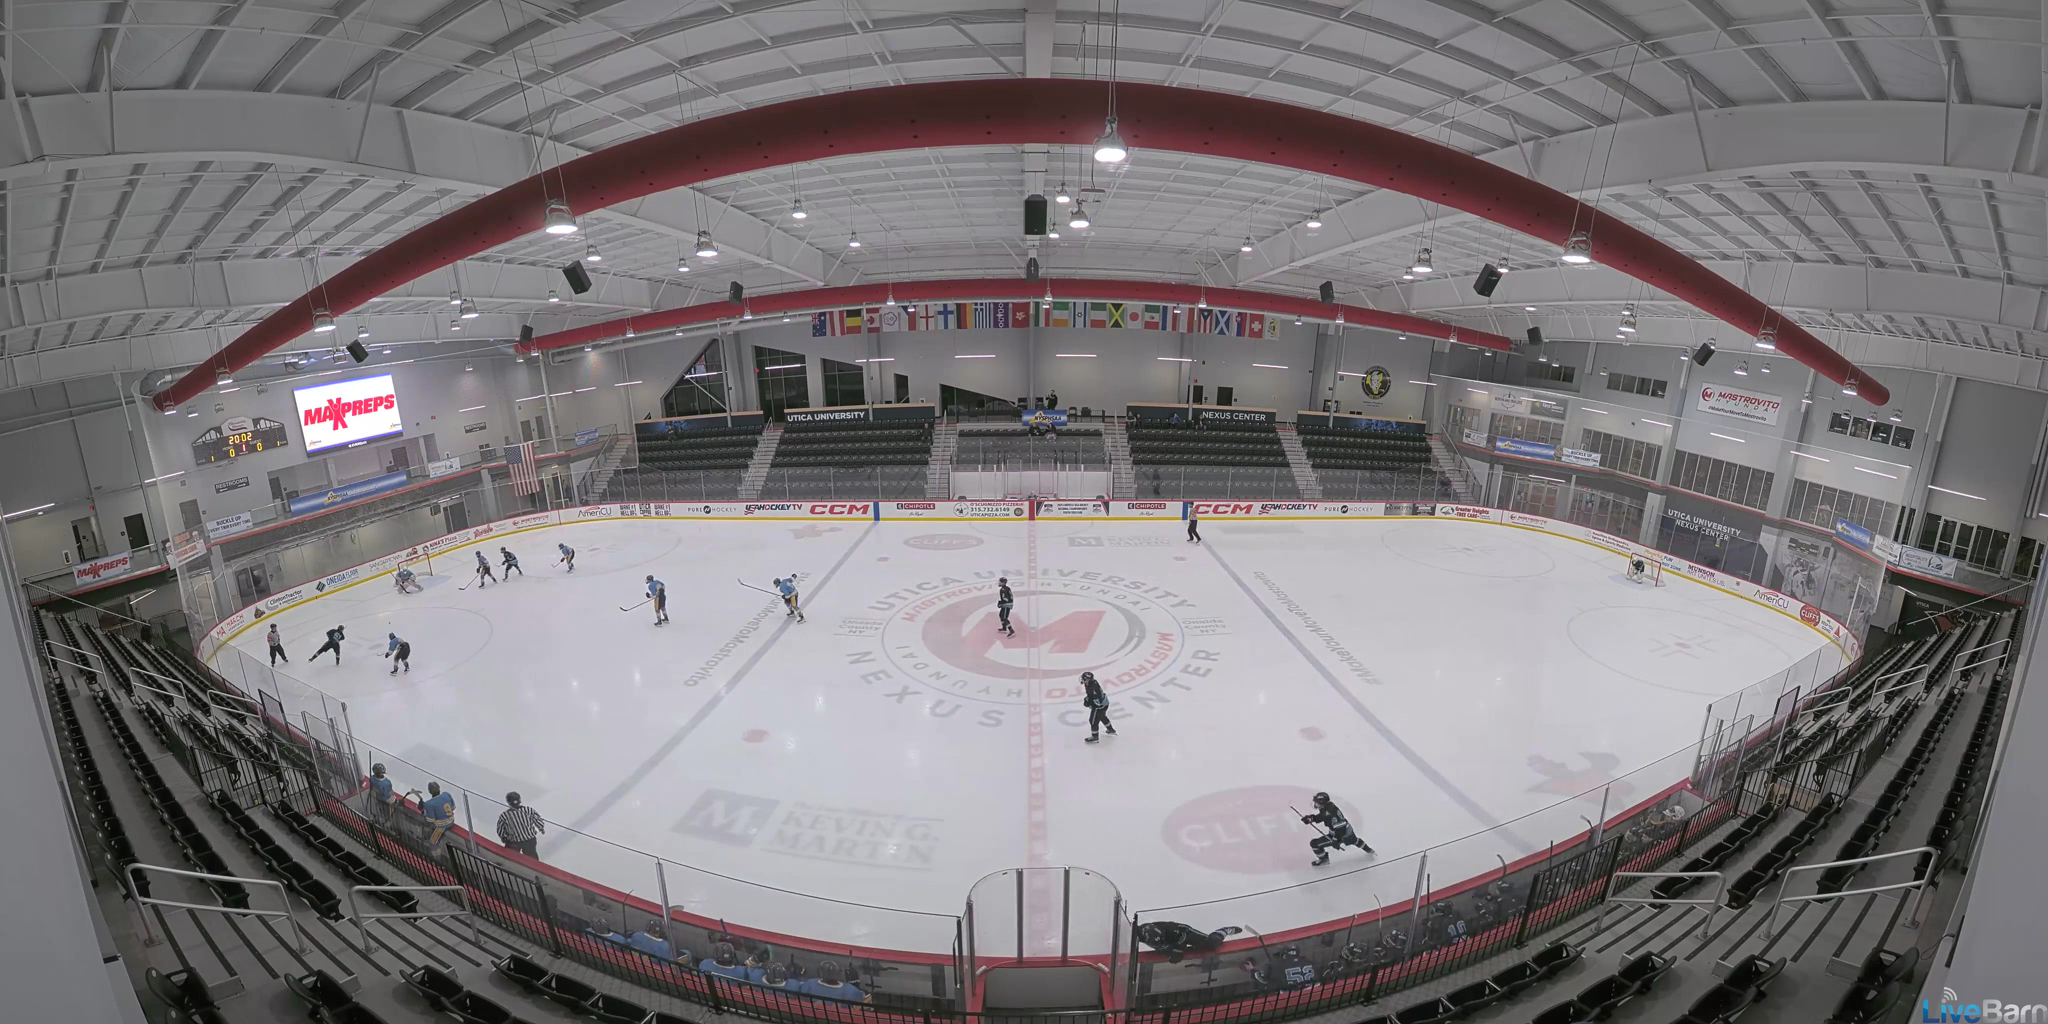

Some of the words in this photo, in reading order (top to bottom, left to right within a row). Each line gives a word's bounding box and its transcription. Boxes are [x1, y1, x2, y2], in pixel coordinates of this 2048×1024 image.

[1716, 398, 1777, 414] HYUNDAI
[1718, 392, 1780, 409] MASTROVITO
[304, 394, 395, 431] MAXPREPS
[787, 413, 812, 422] UTICA
[814, 412, 865, 420] UNIVERSITY
[1202, 411, 1231, 420] NEXUS
[1233, 412, 1266, 421] CENTER
[230, 448, 235, 458] 0
[256, 442, 262, 451] 0
[216, 478, 247, 490] RESTROOMS
[578, 507, 612, 518] AmeriCU
[809, 504, 870, 515] CCM
[1195, 504, 1253, 515] CCM
[216, 518, 234, 526] BUCKLE
[1668, 509, 1691, 521] UTICA
[1693, 516, 1741, 536] UNIVERSITY
[1675, 520, 1699, 532] NEXUS
[1700, 527, 1729, 541] CENTER
[77, 557, 128, 579] MAXPREPS
[1687, 564, 1716, 577] MUNSON
[326, 574, 346, 585] ONEIDA
[867, 576, 964, 612] UTICA
[974, 568, 1197, 610] UNIVERSITY
[901, 581, 1025, 622] MASTROVIO
[1040, 582, 1152, 610] HYUNDAI
[1754, 589, 1789, 609] AmeriCU
[1801, 608, 1820, 622] CLIFF'S
[1045, 632, 1176, 699] MASTROVTO
[846, 650, 1005, 728] NEXUS
[1058, 650, 1220, 728] CENTER
[768, 829, 932, 864] MARTIN
[1285, 964, 1315, 982] 52
